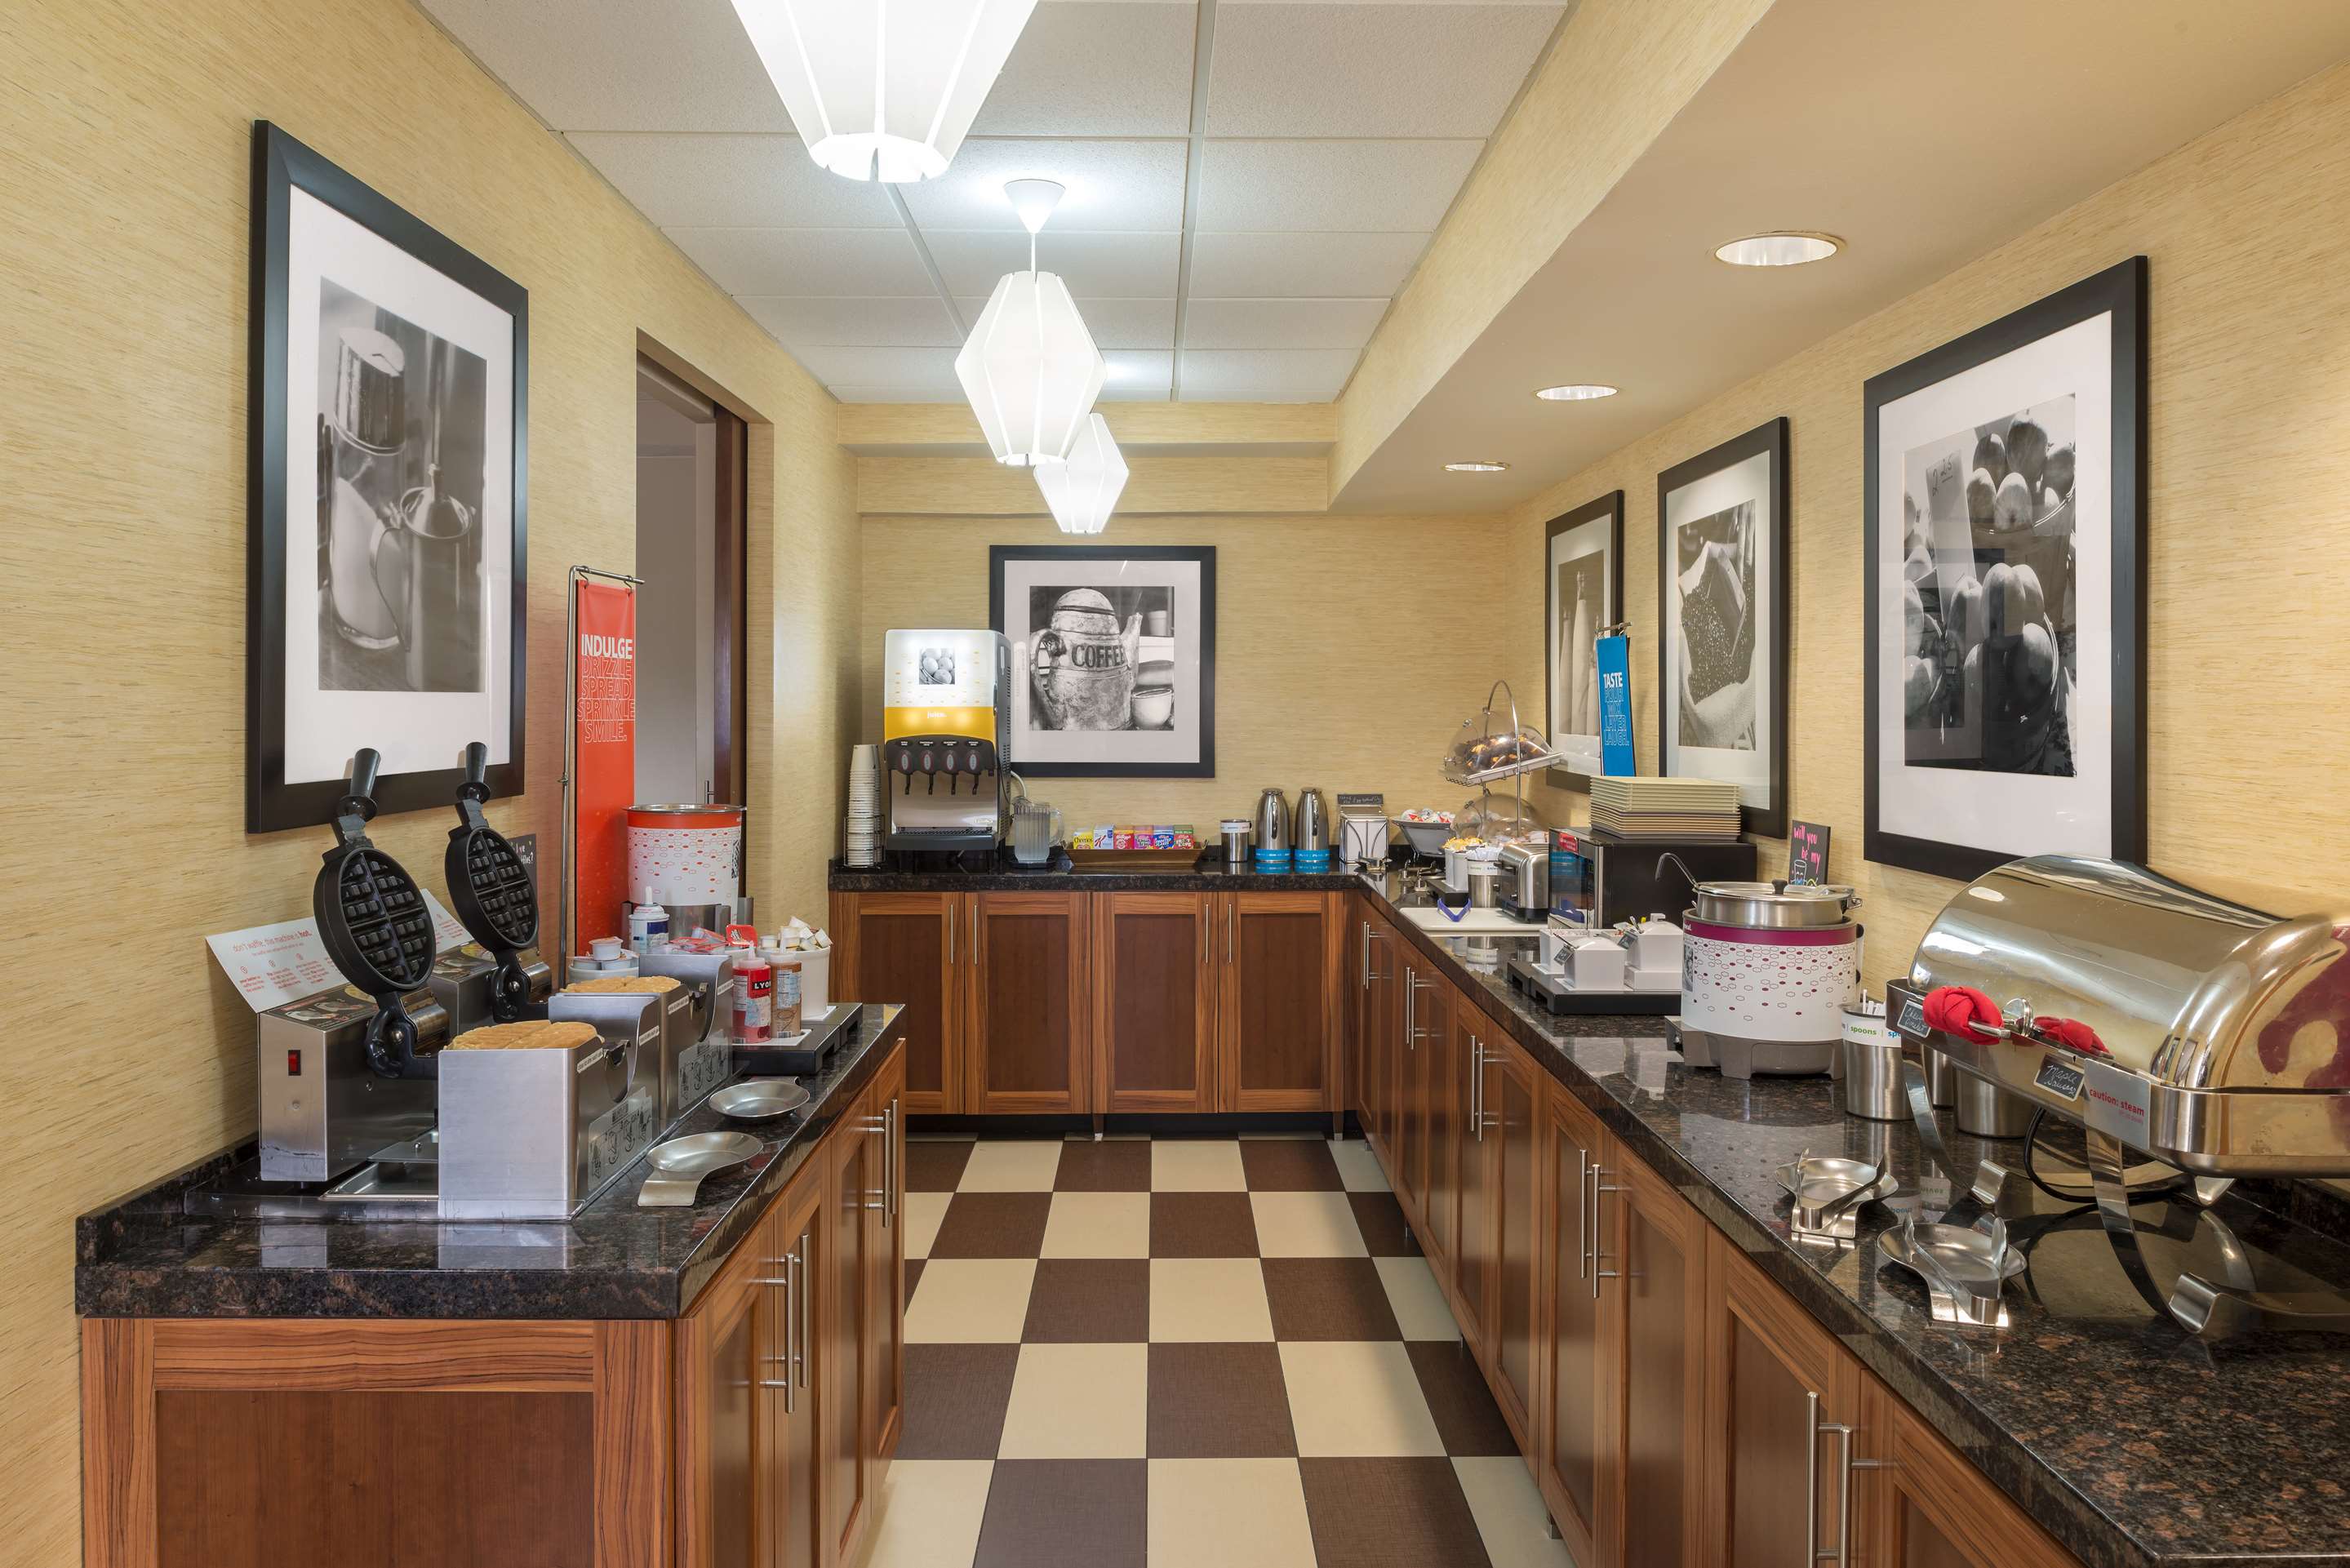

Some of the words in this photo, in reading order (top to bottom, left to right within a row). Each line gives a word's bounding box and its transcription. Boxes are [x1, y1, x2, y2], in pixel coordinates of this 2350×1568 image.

[581, 633, 633, 660] INDULGE
[1071, 645, 1125, 668] COFFEE
[582, 656, 632, 678] DRIZZLE
[581, 676, 632, 700] SPREAD
[1603, 672, 1624, 687] TASTE
[577, 698, 635, 722] SPRINKLE
[584, 720, 628, 743] SMILE.
[1793, 825, 1805, 840] will
[1807, 833, 1818, 850] you
[1801, 846, 1809, 860] be
[1811, 852, 1820, 874] my
[1850, 1025, 1877, 1036] spoons
[2090, 1088, 2119, 1107] caution:
[2121, 1101, 2144, 1117] steam
